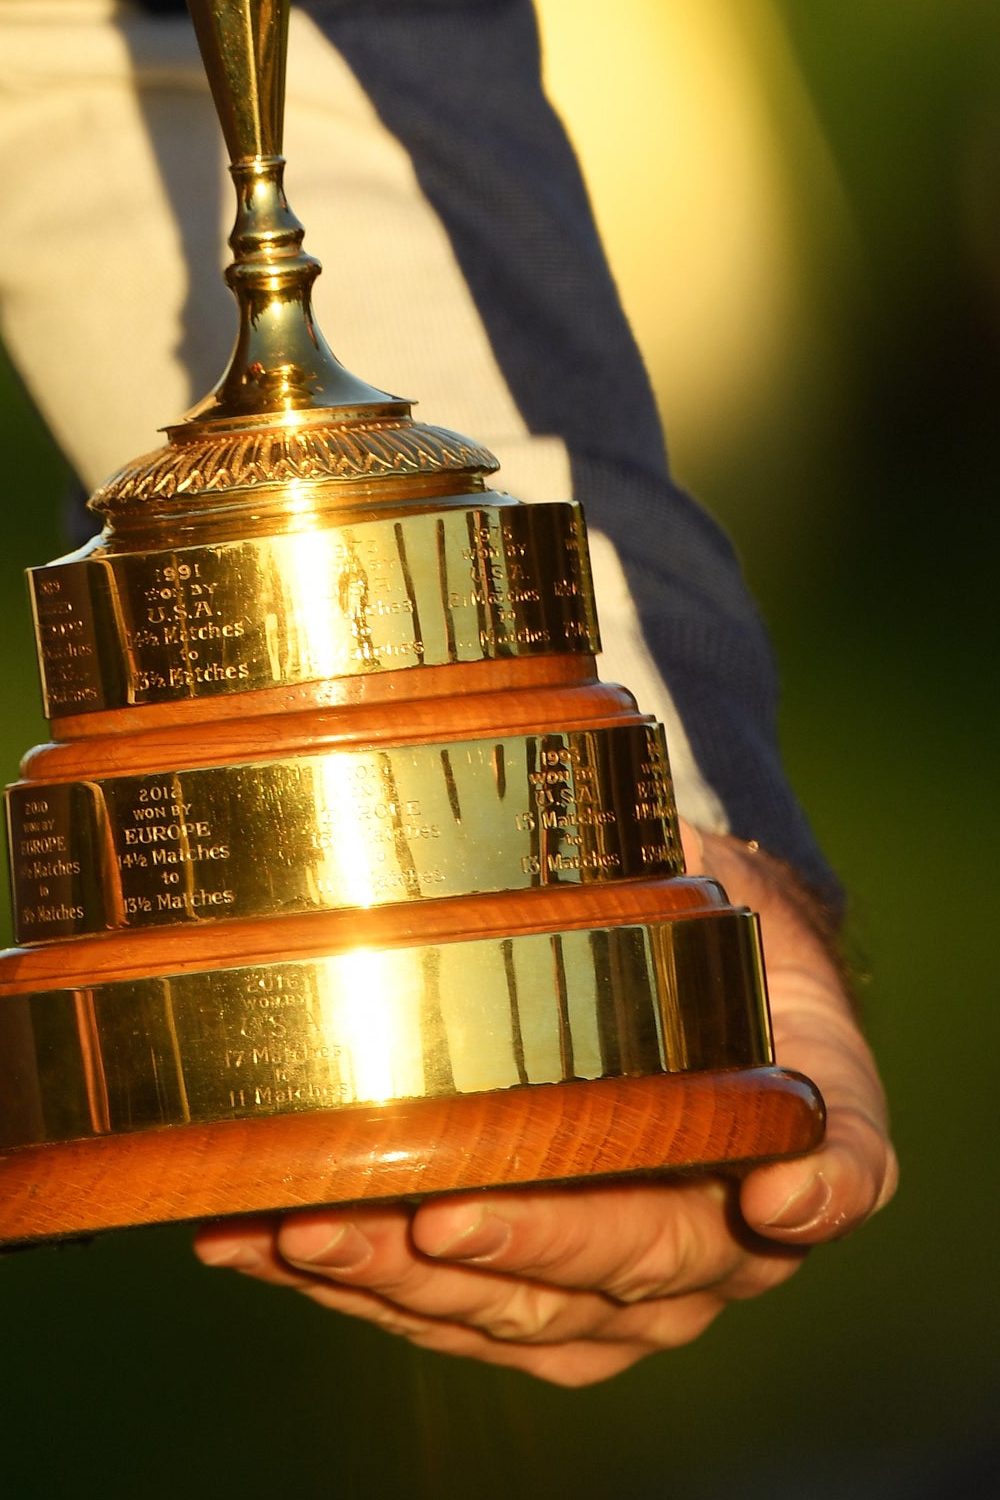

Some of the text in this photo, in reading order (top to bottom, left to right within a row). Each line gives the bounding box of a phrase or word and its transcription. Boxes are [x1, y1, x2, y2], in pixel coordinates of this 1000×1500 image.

[507, 543, 527, 557] BY
[155, 563, 202, 583] 1991
[470, 585, 540, 607] Matches
[163, 620, 246, 645] Matches
[480, 628, 550, 646] Matches
[180, 648, 199, 661] to
[169, 662, 250, 688] Matches
[529, 770, 570, 785] WON
[139, 786, 182, 802] 2012
[25, 801, 48, 816] 2010
[132, 803, 192, 821] WON BY
[542, 808, 616, 830] Matches
[124, 821, 211, 845] EUROPE
[565, 833, 583, 846] to
[20, 836, 67, 856] EUROPE
[151, 844, 231, 866] Matches
[33, 859, 81, 879] Matches
[547, 850, 621, 873] Matches
[161, 870, 180, 885] to
[39, 884, 50, 898] to
[156, 888, 236, 911] Matches
[37, 903, 85, 924] Matches
[225, 1050, 245, 1069] 17
[229, 1083, 349, 1108] 11 Matches
